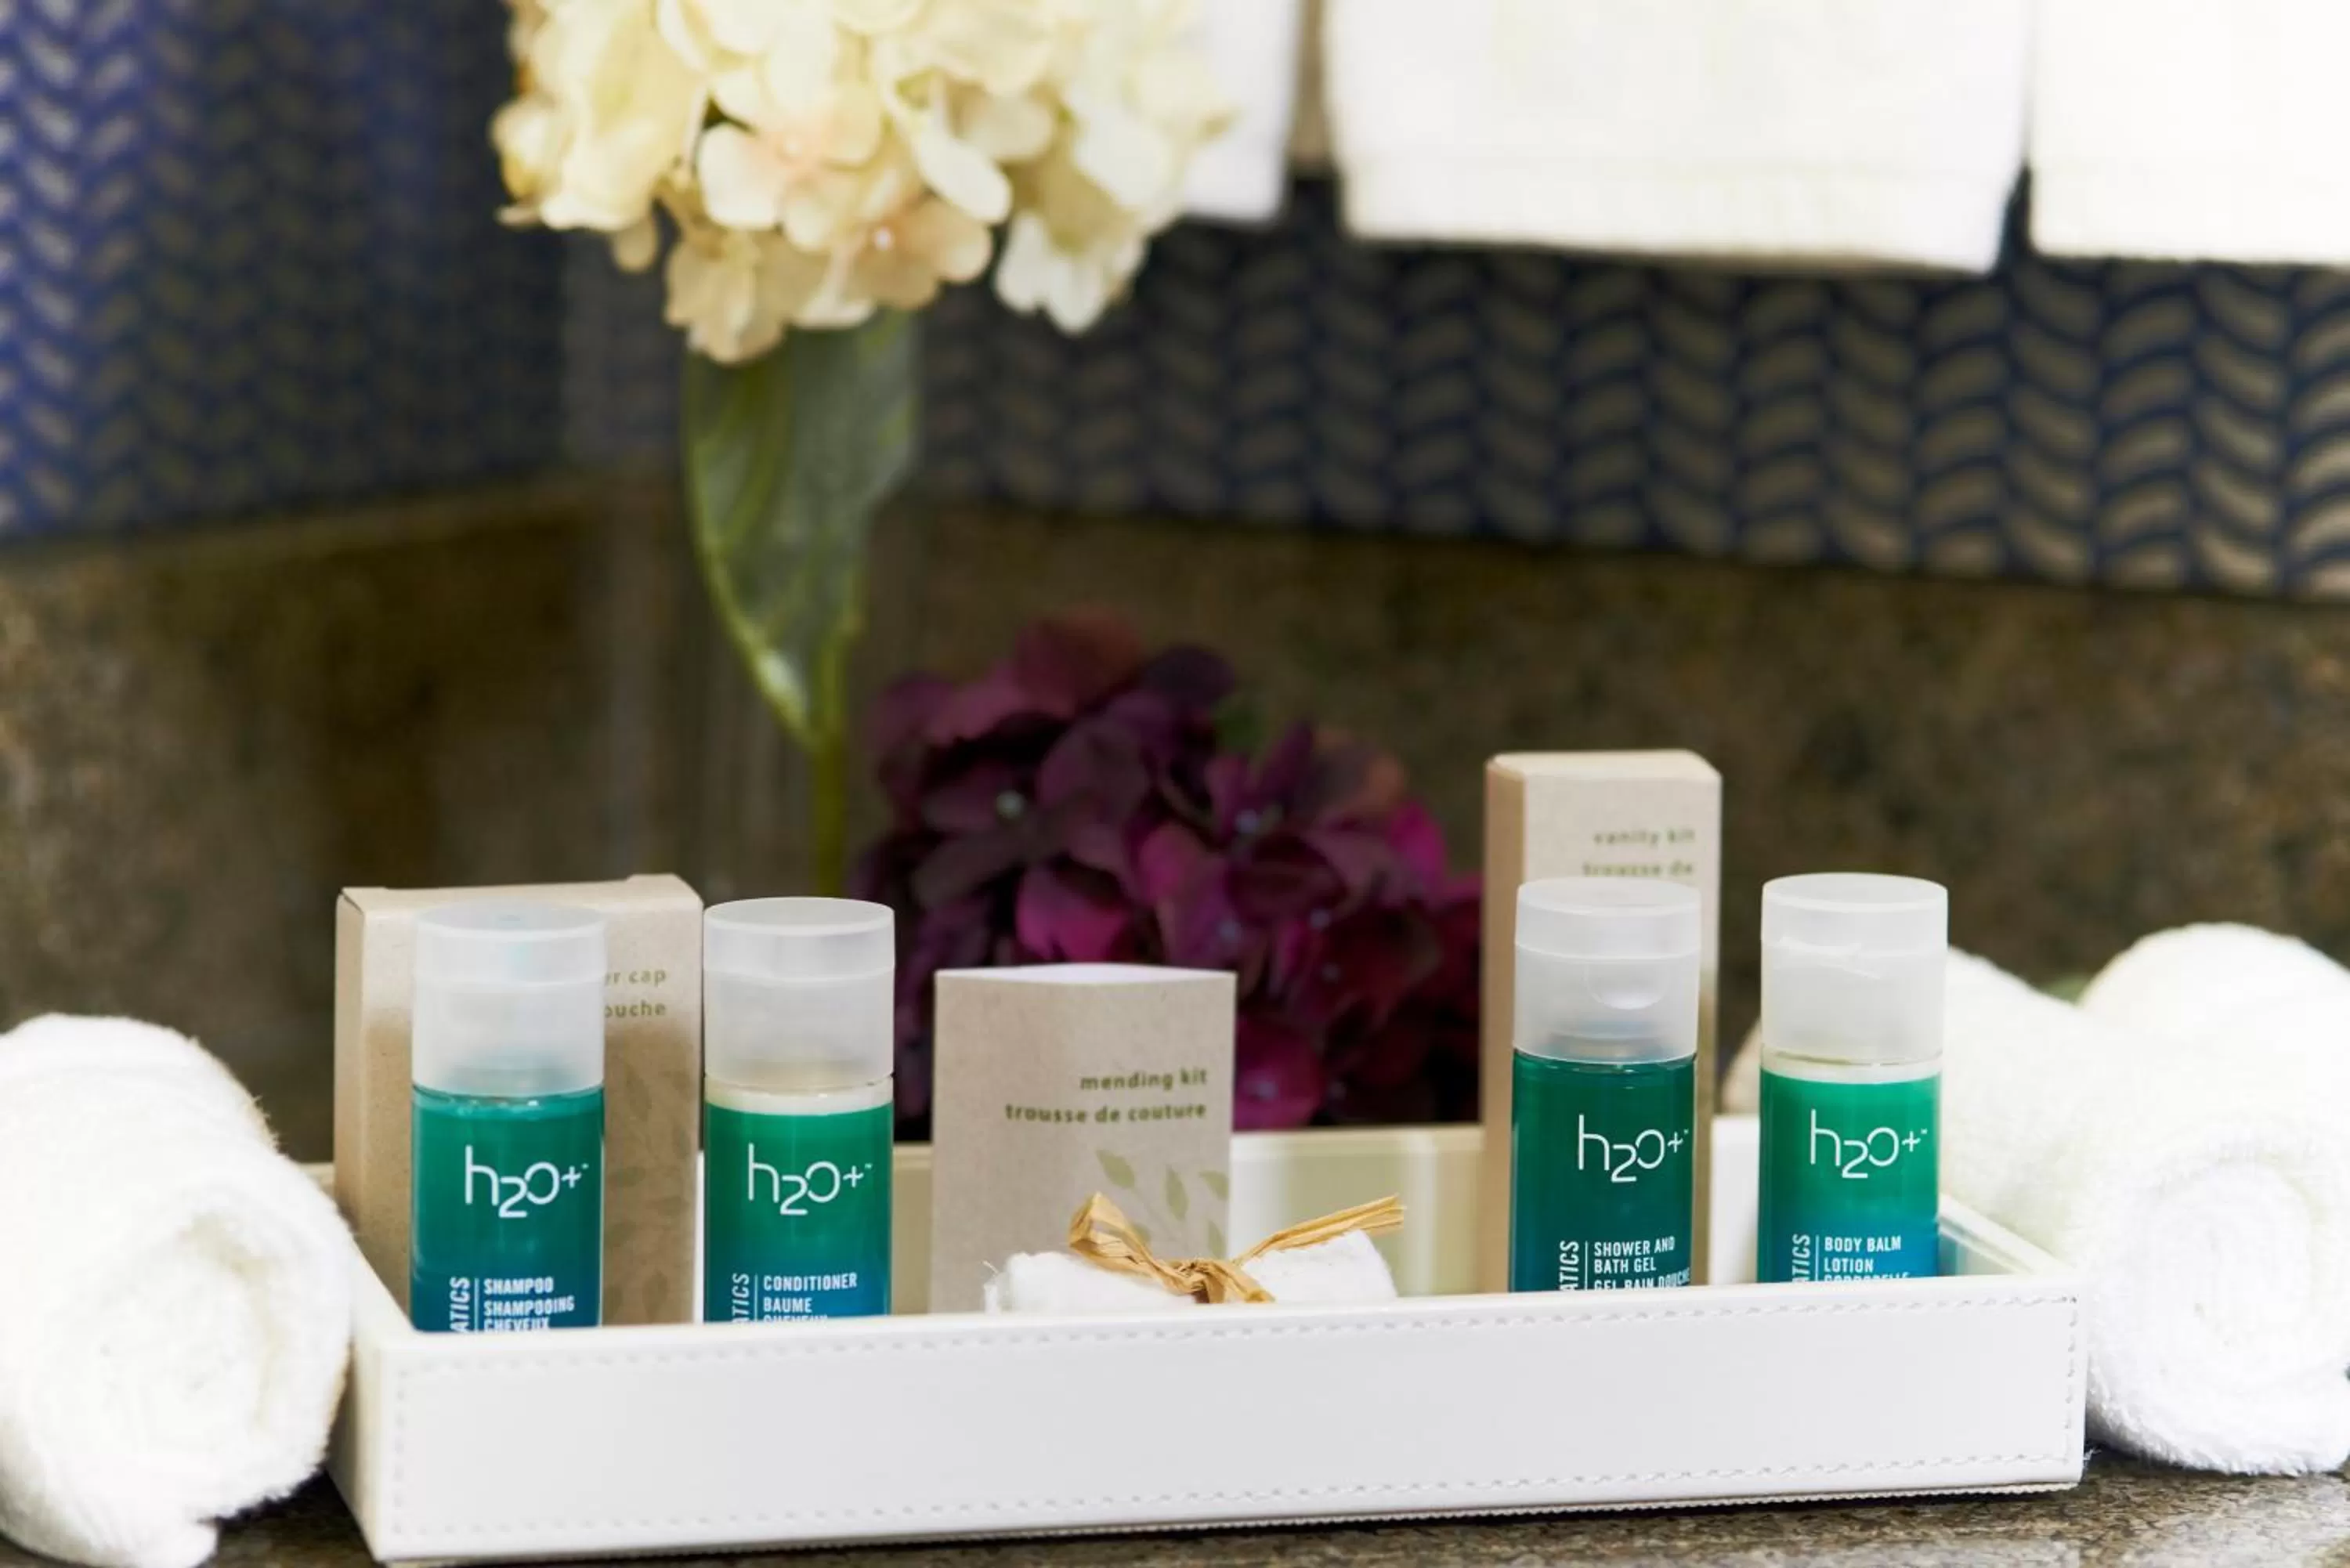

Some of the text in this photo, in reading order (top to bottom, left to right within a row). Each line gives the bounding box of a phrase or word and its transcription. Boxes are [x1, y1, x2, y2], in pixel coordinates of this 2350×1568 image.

[628, 970, 667, 988] cap
[1080, 1067, 1207, 1091] mending kit
[1005, 1103, 1206, 1122] trousse de couture
[1594, 1235, 1676, 1257] SHOWER AND
[1824, 1235, 1901, 1252] BODY BALM
[1594, 1256, 1657, 1274] BATH GEL
[1824, 1257, 1874, 1273] LOTION
[483, 1277, 554, 1295] SHAMPOO
[763, 1272, 858, 1292] CONDITIONER
[483, 1295, 575, 1317] SHAMPOOING
[763, 1296, 812, 1313] BAUME
